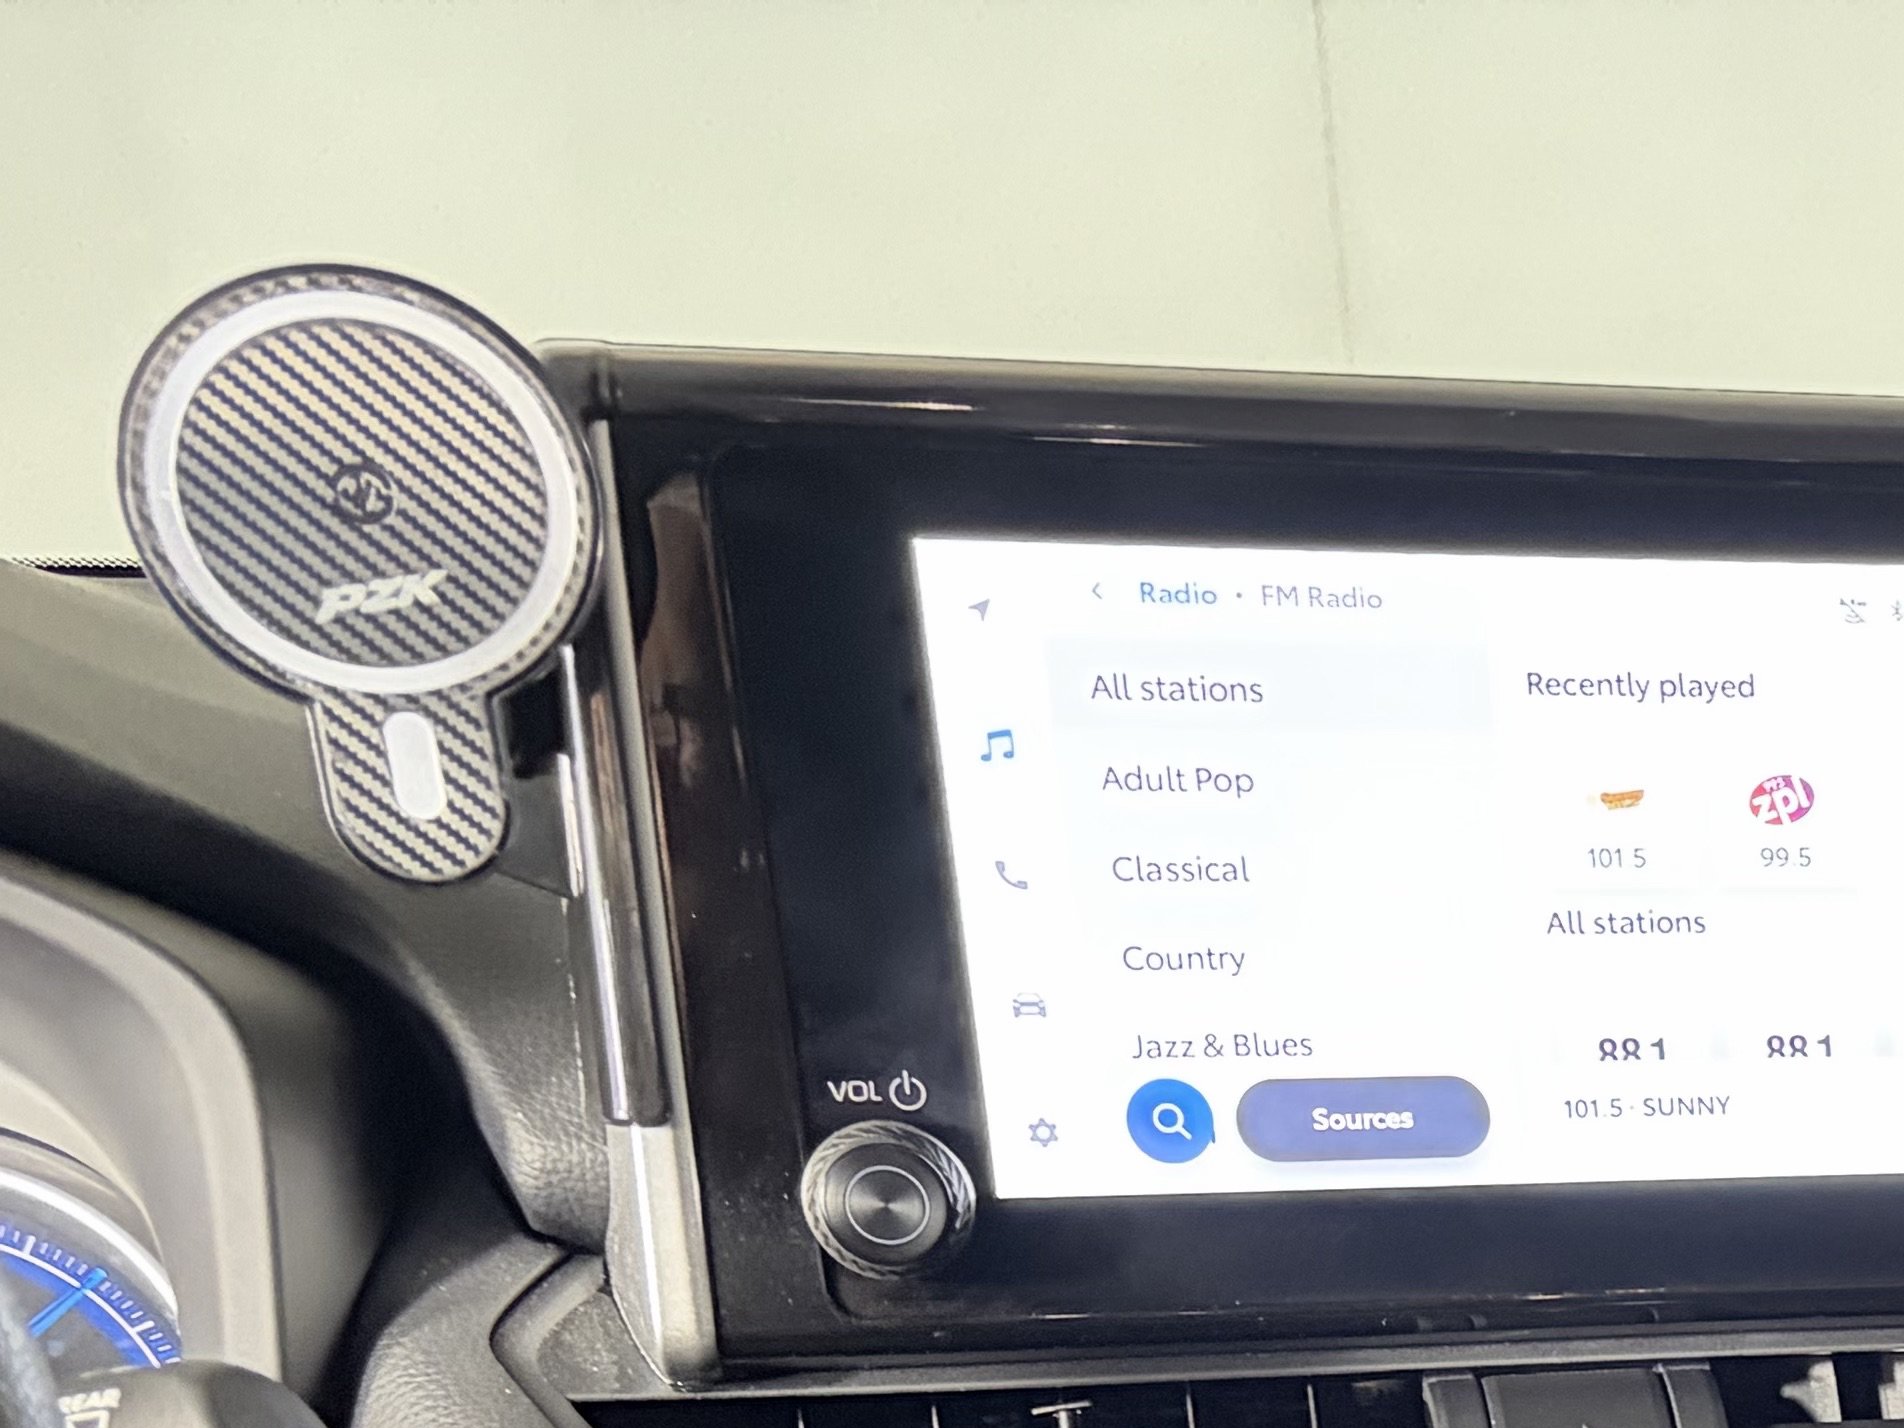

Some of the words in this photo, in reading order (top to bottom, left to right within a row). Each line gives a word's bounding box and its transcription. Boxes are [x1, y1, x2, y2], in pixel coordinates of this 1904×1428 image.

[1139, 582, 1218, 606] Radio
[1261, 585, 1299, 607] FM
[1309, 586, 1383, 609] Radio
[1091, 675, 1132, 701] All
[1141, 676, 1264, 704] stations
[1526, 672, 1651, 701] Recently
[1659, 674, 1755, 704] played
[1103, 767, 1187, 793] Adult
[1196, 768, 1255, 798] Pop
[1112, 855, 1250, 883] Classical
[1760, 847, 1812, 867] 99.5
[1547, 911, 1584, 935] All
[1594, 910, 1706, 936] stations
[1123, 946, 1246, 975] Country
[1133, 1035, 1194, 1059] Jazz
[1203, 1034, 1225, 1058] &
[1233, 1032, 1313, 1058] Blues
[826, 1080, 883, 1102] VOL
[1312, 1108, 1414, 1131] Sources
[1564, 1097, 1623, 1119] 101.5
[1643, 1095, 1731, 1117] SUNNY
